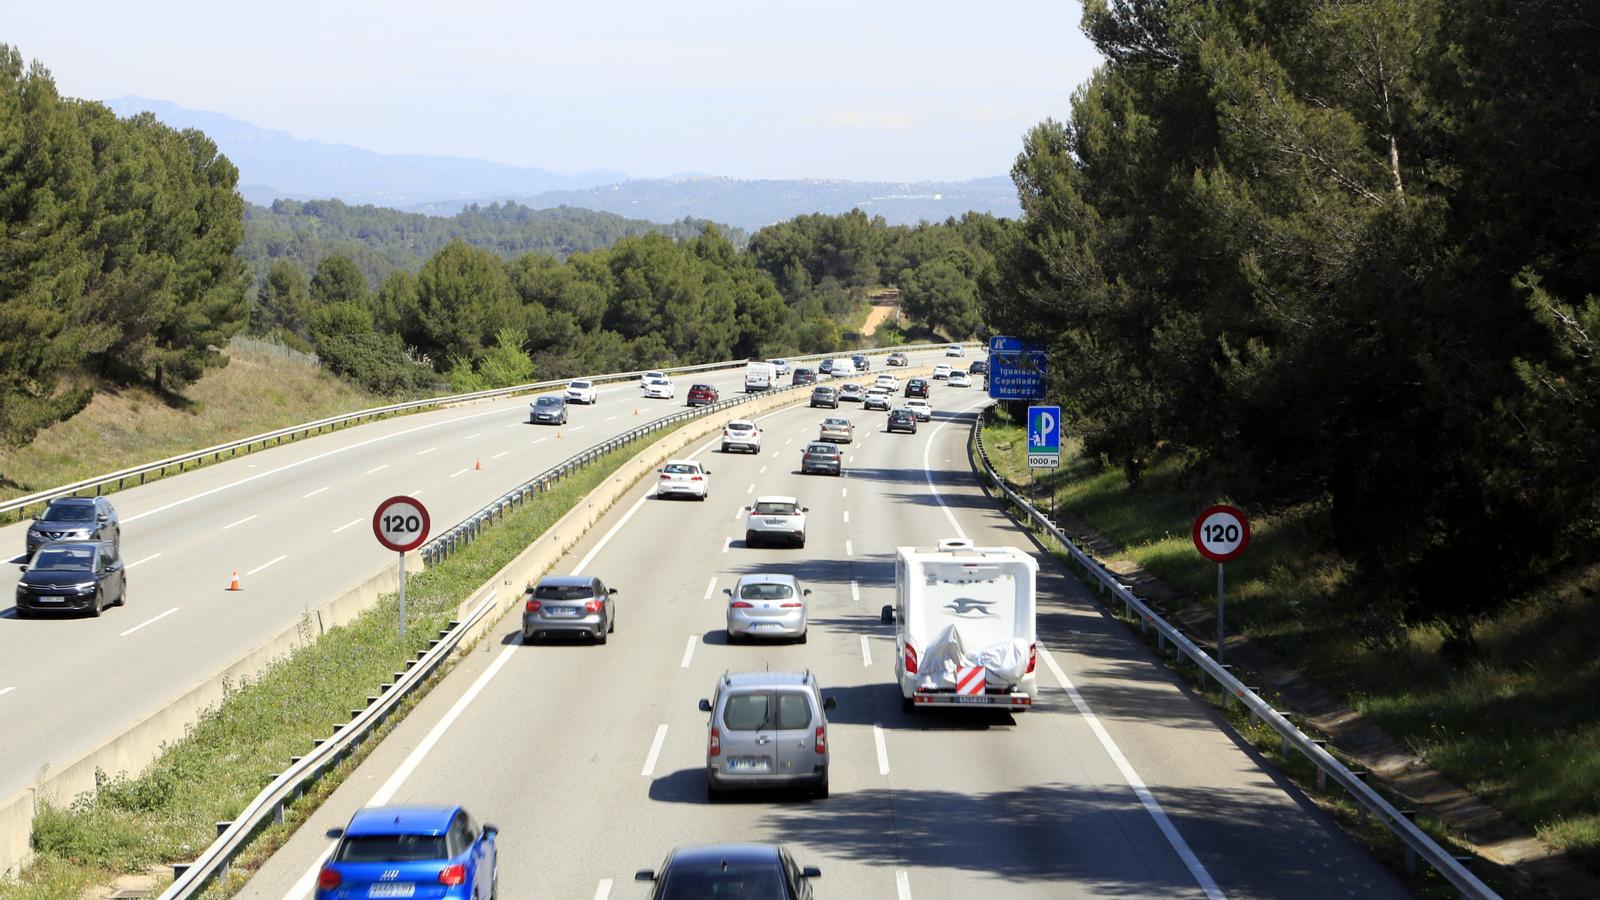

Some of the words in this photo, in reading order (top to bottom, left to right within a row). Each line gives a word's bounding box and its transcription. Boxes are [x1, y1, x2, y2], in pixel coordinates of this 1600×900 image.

[1041, 412, 1055, 446] P
[1030, 457, 1049, 465] 1000
[383, 515, 420, 533] 120
[1204, 524, 1239, 543] 120
